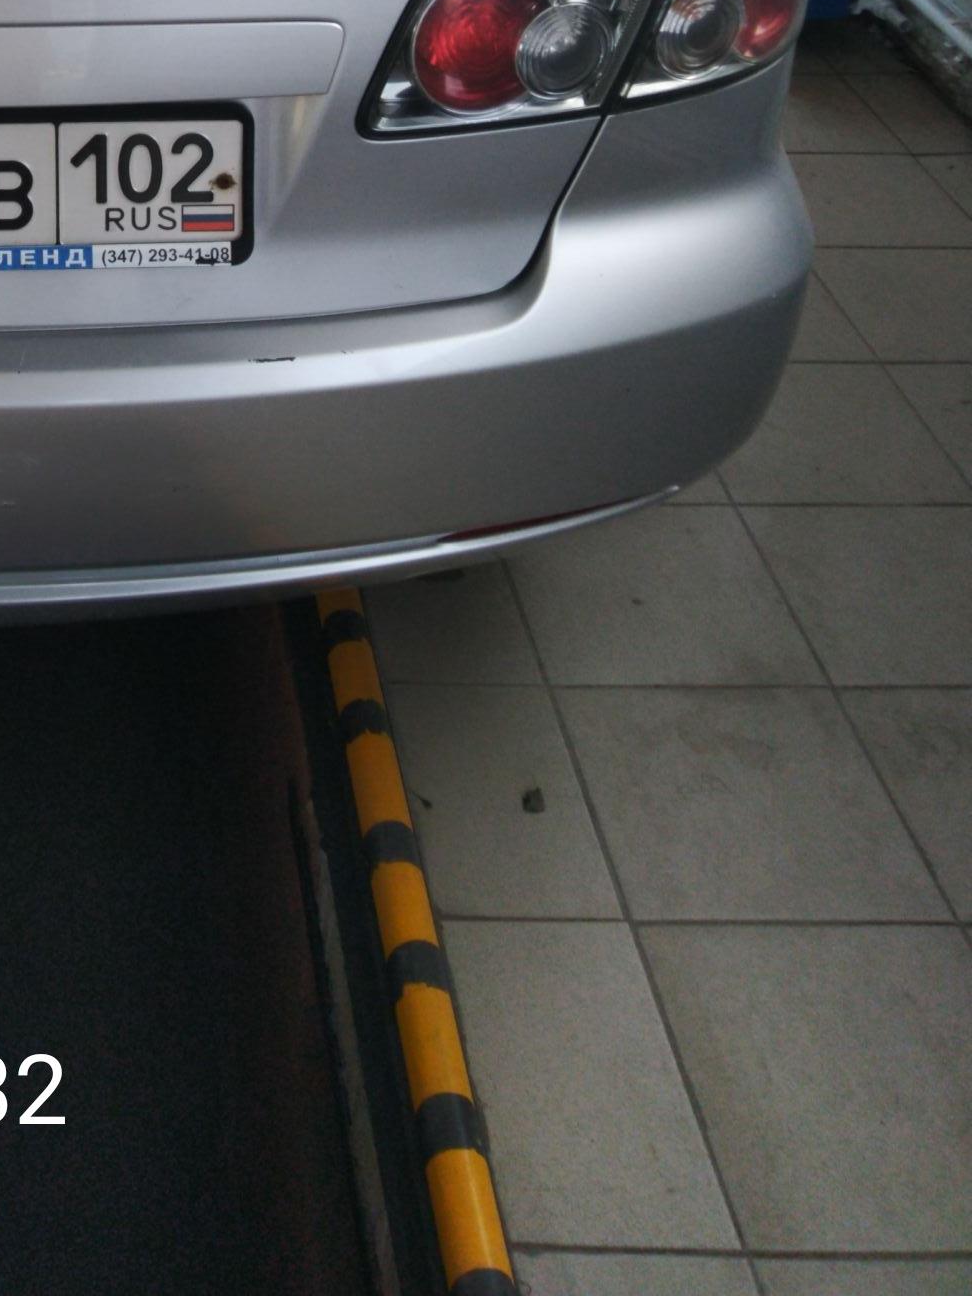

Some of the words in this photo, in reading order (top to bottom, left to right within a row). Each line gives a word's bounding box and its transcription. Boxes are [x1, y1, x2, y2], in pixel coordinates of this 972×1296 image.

[70, 132, 214, 204] 102
[105, 207, 177, 232] RUS
[101, 248, 143, 266] (347)
